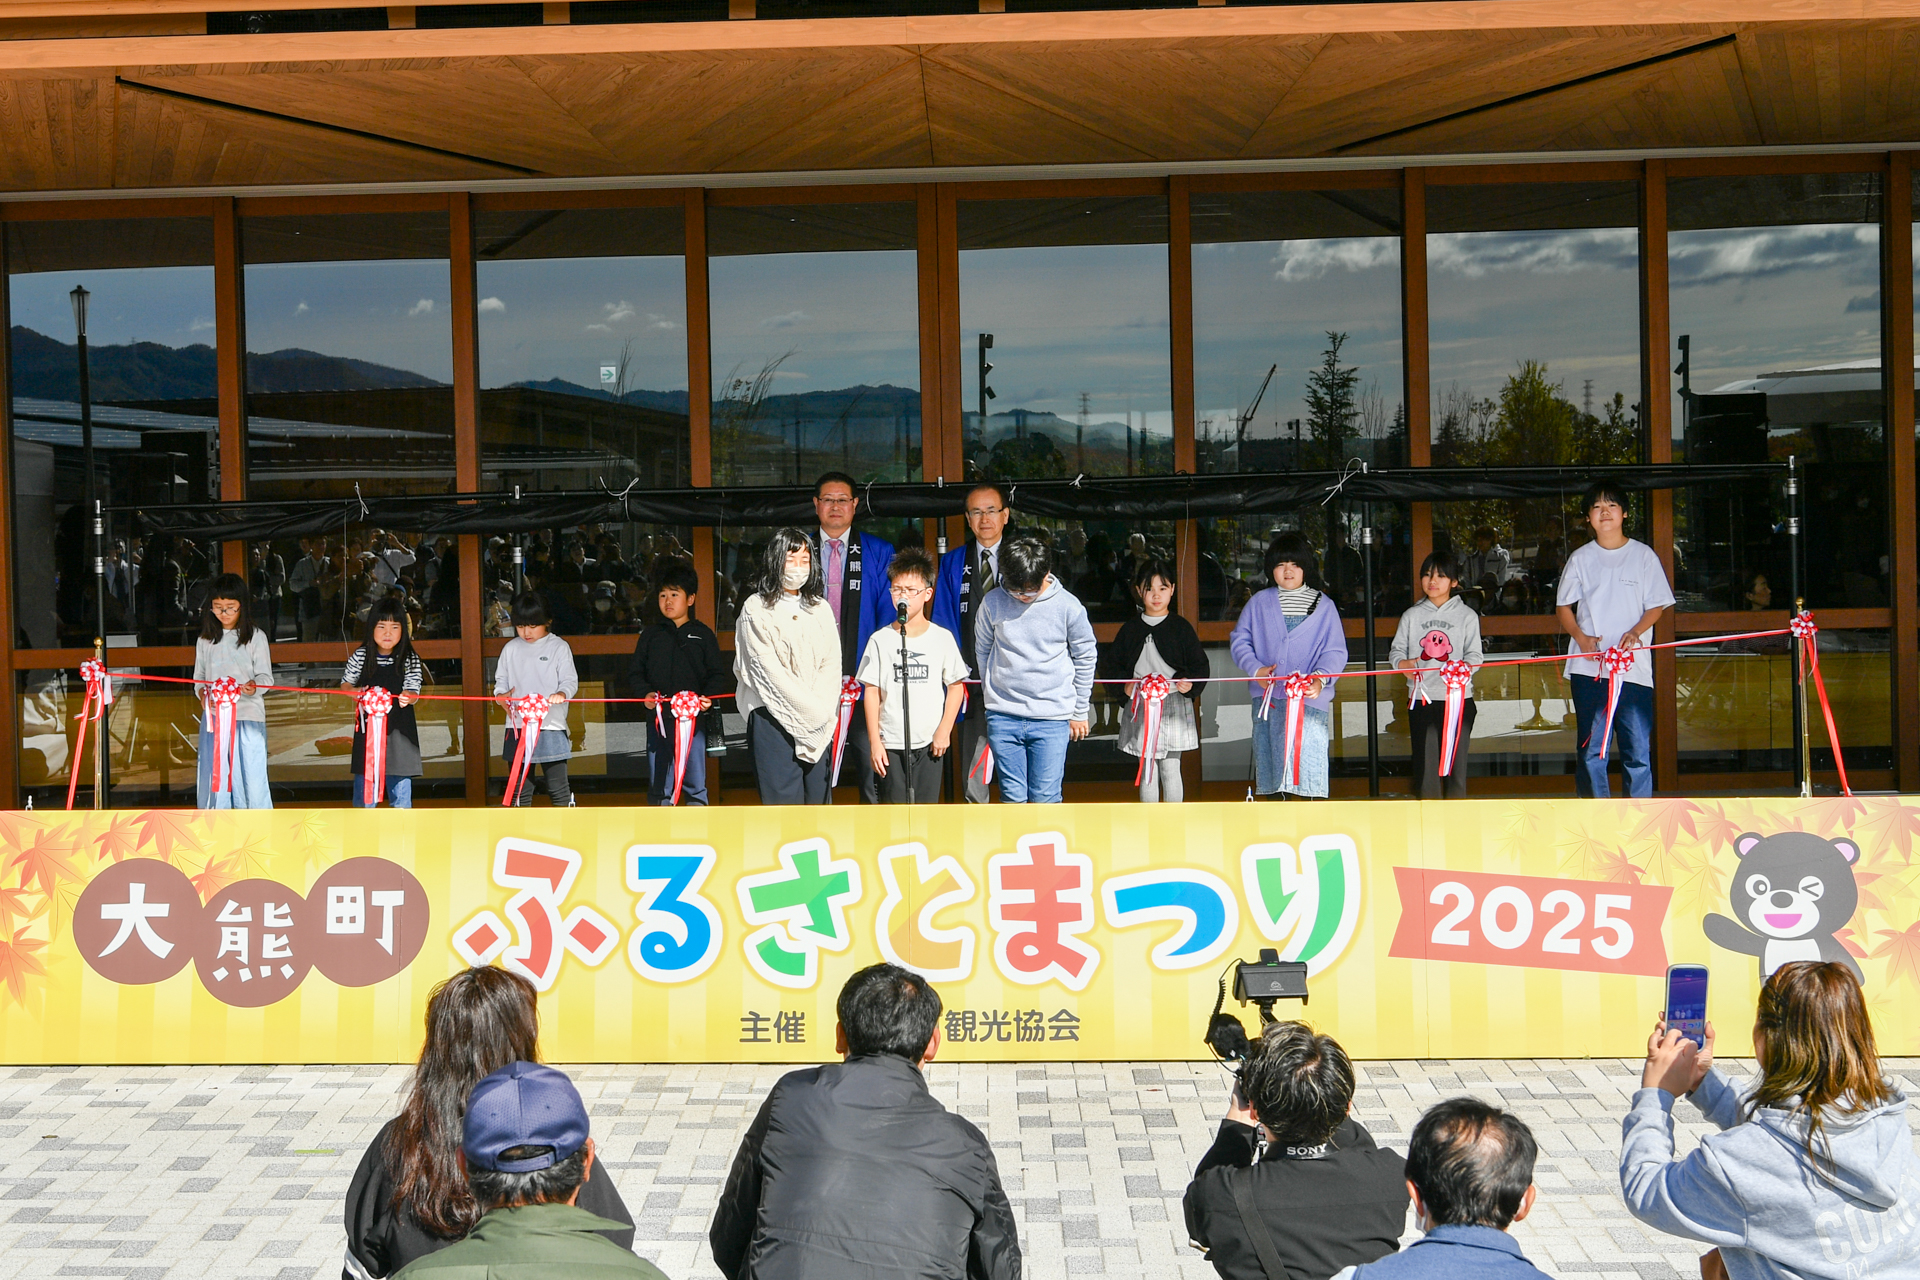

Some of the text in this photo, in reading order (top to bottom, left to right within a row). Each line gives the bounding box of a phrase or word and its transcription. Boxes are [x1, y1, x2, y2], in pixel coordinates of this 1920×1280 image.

[849, 543, 861, 590] 大熊町
[960, 564, 972, 613] 大熊町
[1421, 619, 1454, 630] KIRBY
[896, 666, 928, 678] CUMS
[98, 882, 404, 983] 大熊町
[454, 832, 1360, 991] ふるさとまつり
[1428, 881, 1634, 960] 2025
[740, 1009, 1081, 1044] 主催 観光協会
[1286, 1143, 1328, 1156] SONY
